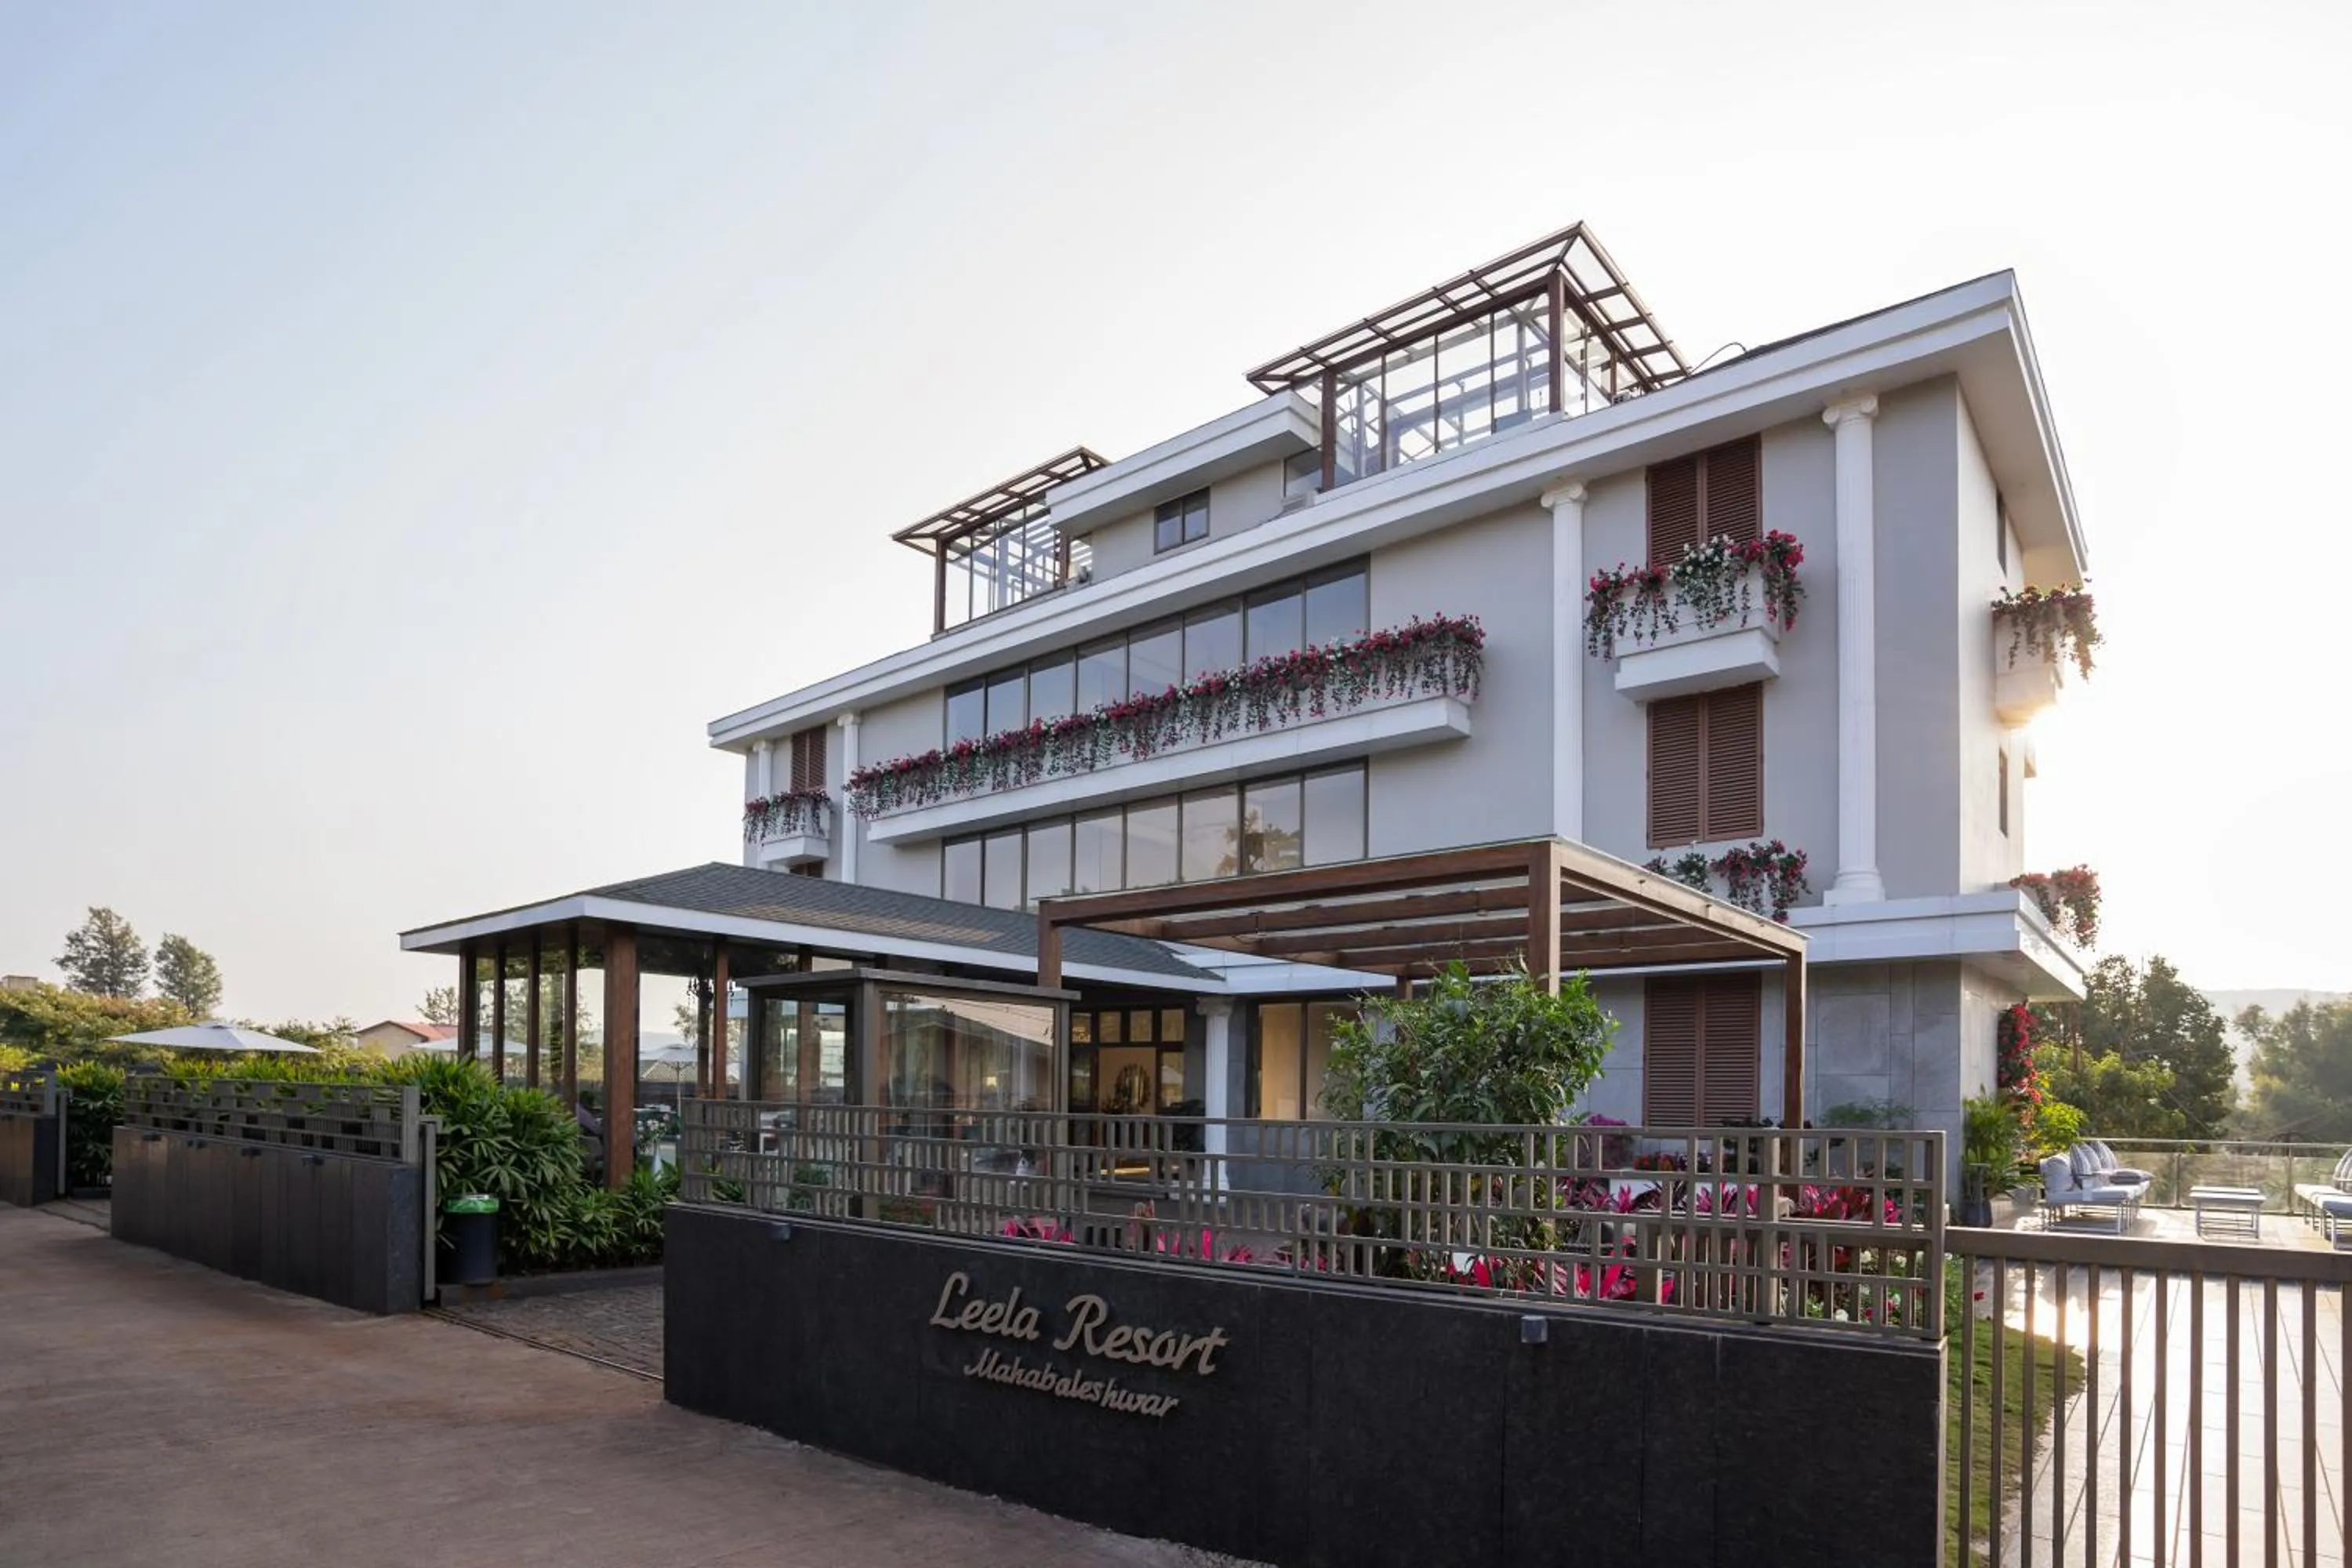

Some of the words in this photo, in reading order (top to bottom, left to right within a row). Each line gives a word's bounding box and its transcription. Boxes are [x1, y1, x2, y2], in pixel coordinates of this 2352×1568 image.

[931, 1272, 1040, 1339] Leela
[1054, 1294, 1229, 1374] Resort
[964, 1348, 1179, 1417] Mahabaleshwar
